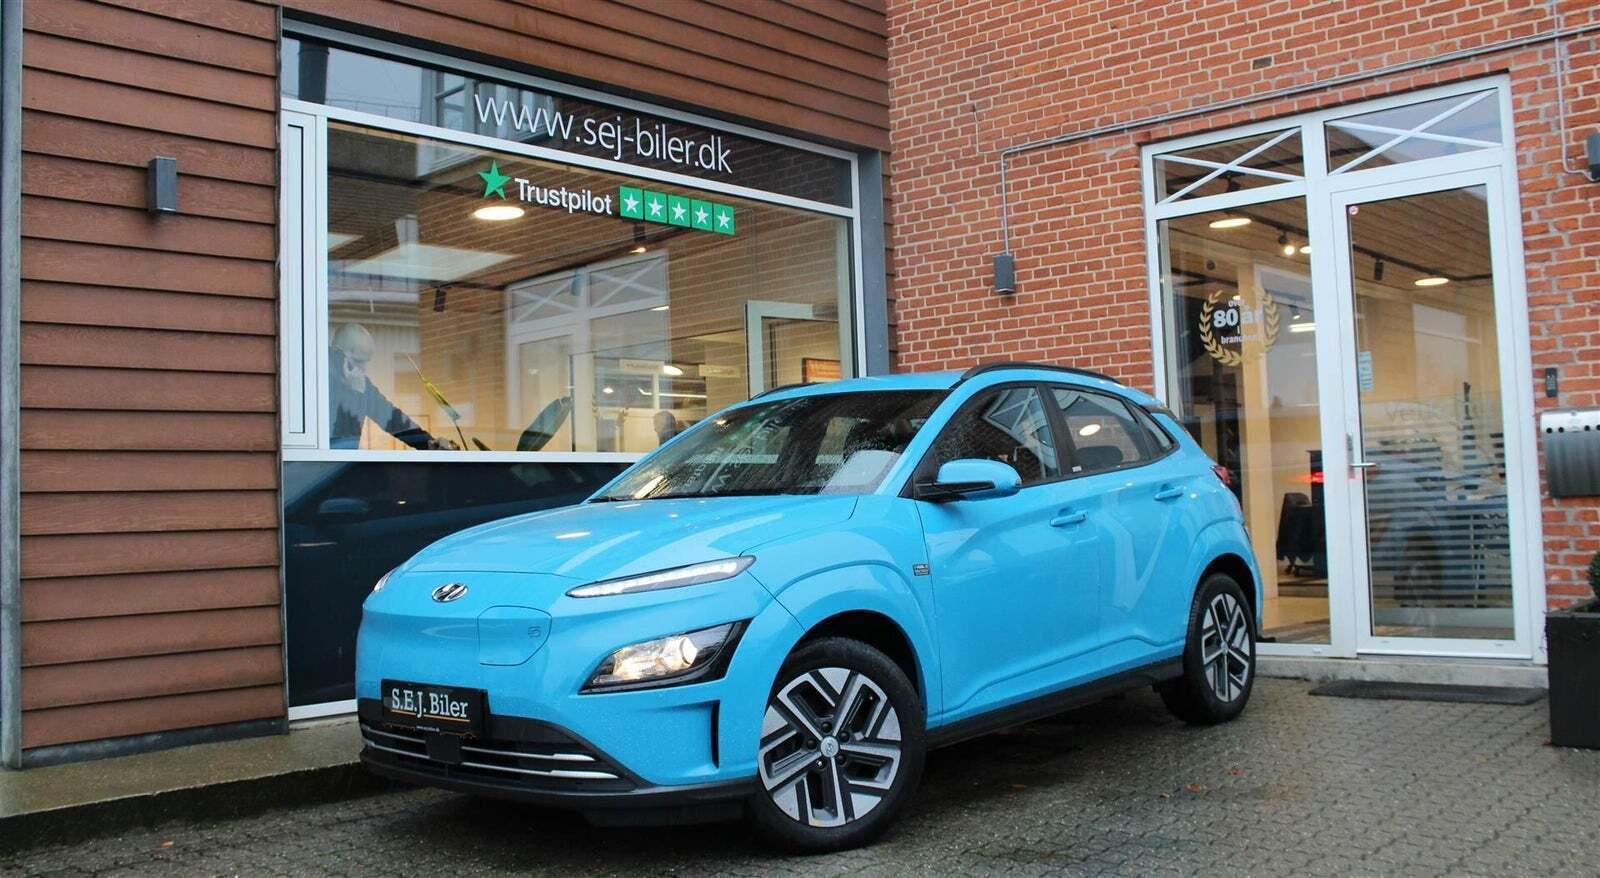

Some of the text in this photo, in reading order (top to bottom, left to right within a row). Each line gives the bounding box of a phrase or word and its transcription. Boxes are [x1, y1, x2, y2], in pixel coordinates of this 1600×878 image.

[475, 94, 733, 174] www.sej-biler.dk
[515, 178, 612, 215] Trustpilot
[1213, 308, 1239, 328] 80
[391, 688, 469, 718] S.E.J. Biler
